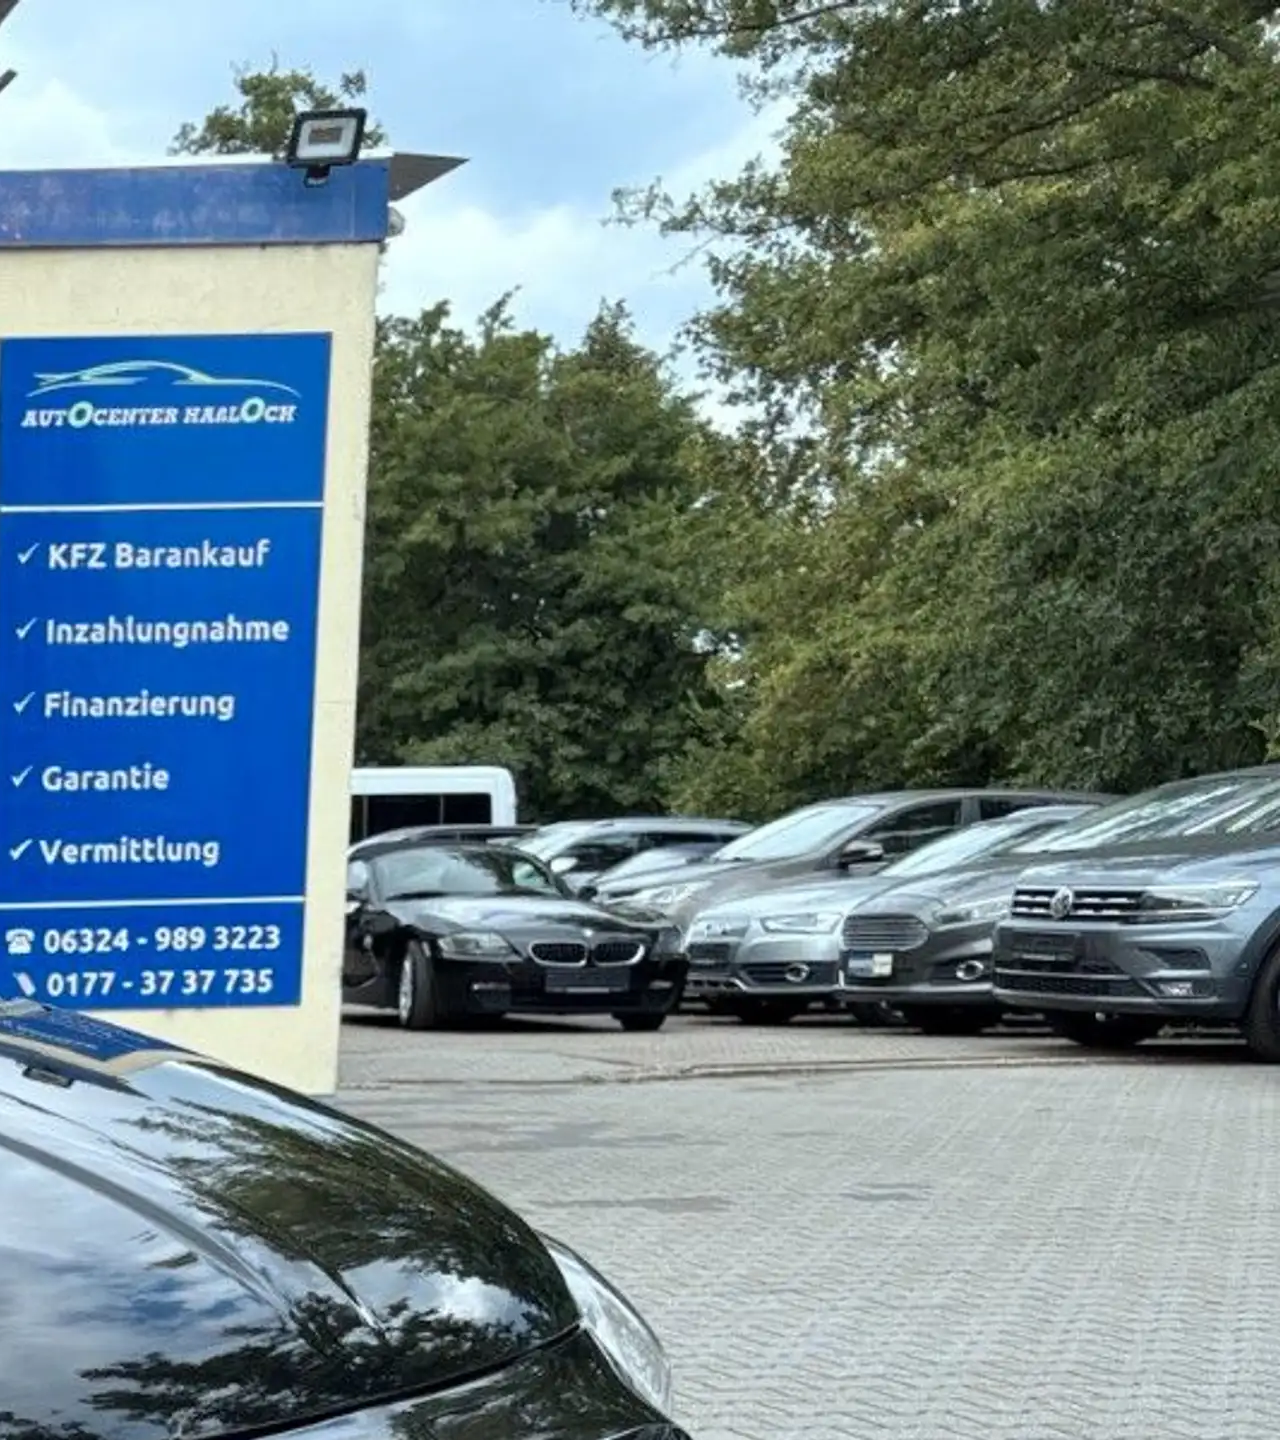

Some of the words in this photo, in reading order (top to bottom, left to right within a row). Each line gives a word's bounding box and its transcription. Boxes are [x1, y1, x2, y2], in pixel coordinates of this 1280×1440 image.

[20, 400, 178, 428] AUTOCENTER
[48, 542, 106, 570] KFZ
[115, 538, 271, 569] Barankauf
[45, 613, 290, 648] Inzahlungnahme
[44, 688, 236, 721] Finanzierung
[41, 762, 170, 792] Garantie
[39, 835, 221, 867] Vermittlung
[43, 928, 129, 954] 06324
[154, 926, 207, 951] 989
[213, 925, 281, 951] 3223
[46, 971, 115, 997] 0177
[140, 970, 175, 996] 37
[181, 970, 216, 995] 37
[224, 969, 274, 994] 735
